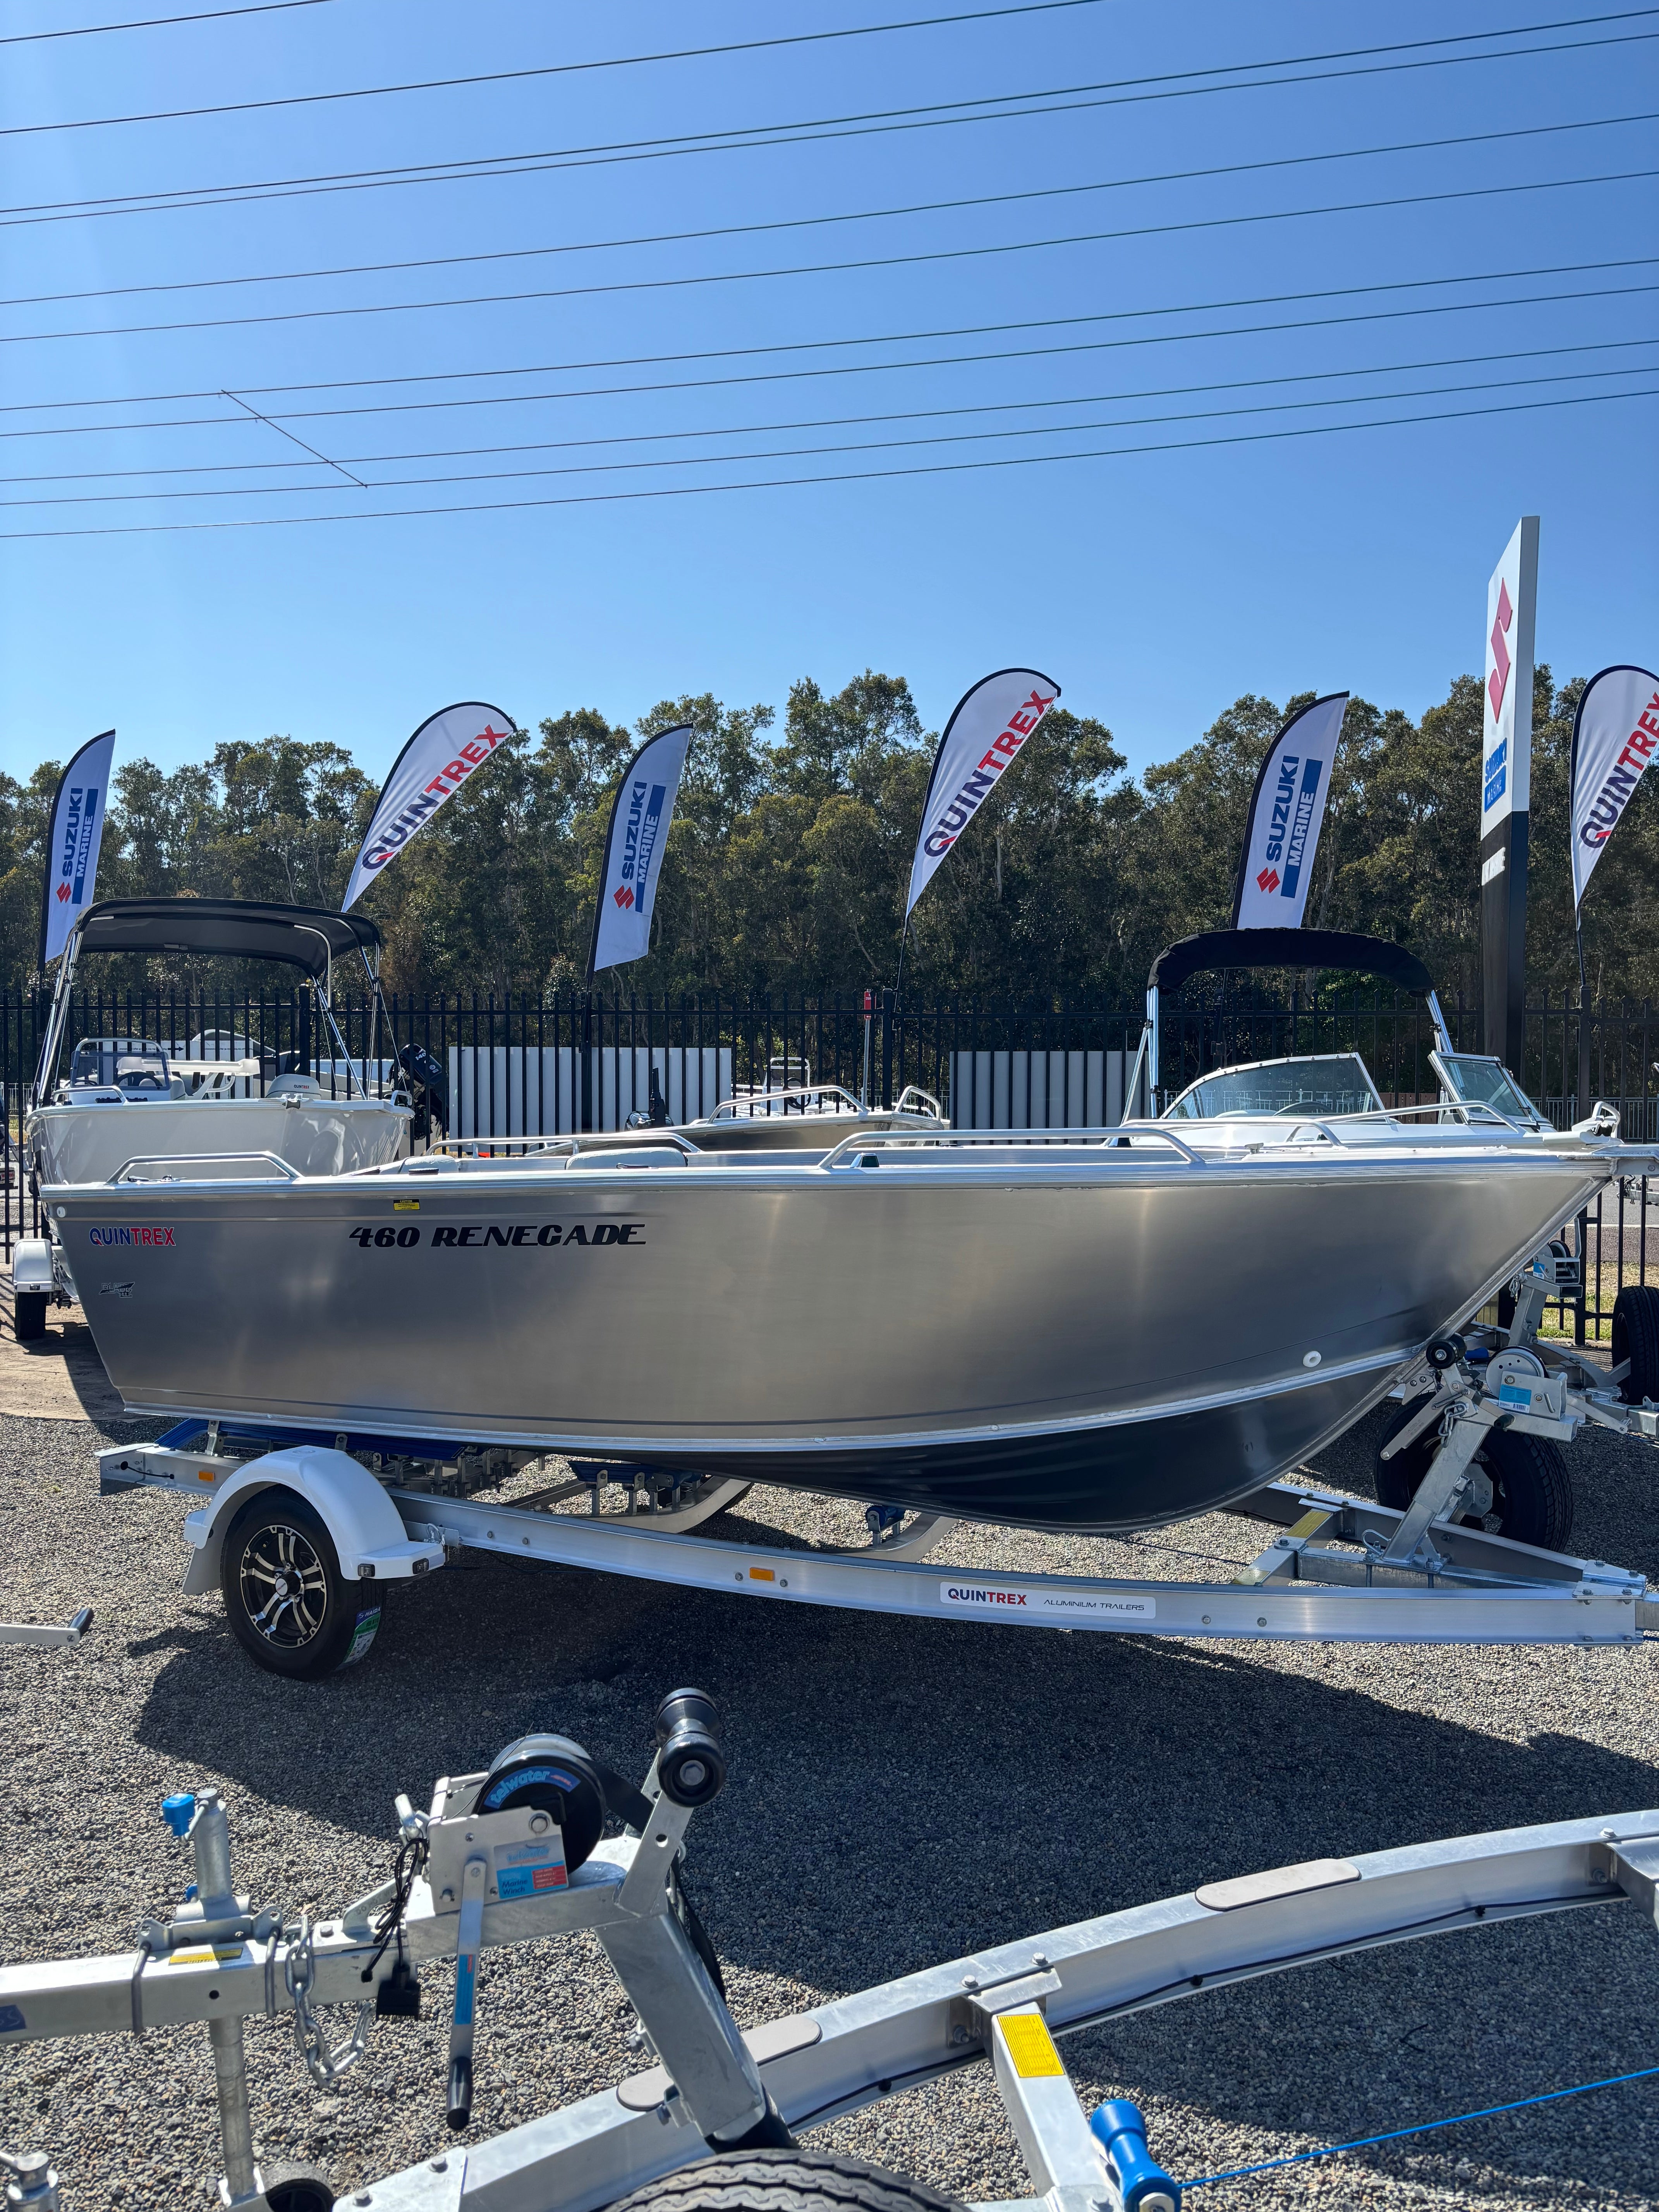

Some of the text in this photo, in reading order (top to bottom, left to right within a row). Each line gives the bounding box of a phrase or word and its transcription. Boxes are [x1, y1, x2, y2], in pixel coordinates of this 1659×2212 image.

[362, 724, 509, 870] QUINTREX
[924, 690, 1054, 857] QUINTREX
[62, 788, 83, 877] SUZUKI
[622, 781, 647, 880] SUZUKI
[1266, 756, 1299, 862] SUZUKI
[1288, 792, 1314, 867] MARINE
[76, 816, 93, 877] MARINE
[638, 814, 658, 883] MARINE
[89, 1227, 176, 1246] QUINTREX
[349, 1224, 647, 1248] 460 RENEGADE
[948, 1588, 1027, 1606] QUINTREX
[1044, 1599, 1096, 1608] ALUMINIUM
[490, 1770, 550, 1803] telwater
[502, 1879, 527, 1888] Marine
[503, 1886, 525, 1895] Winch
